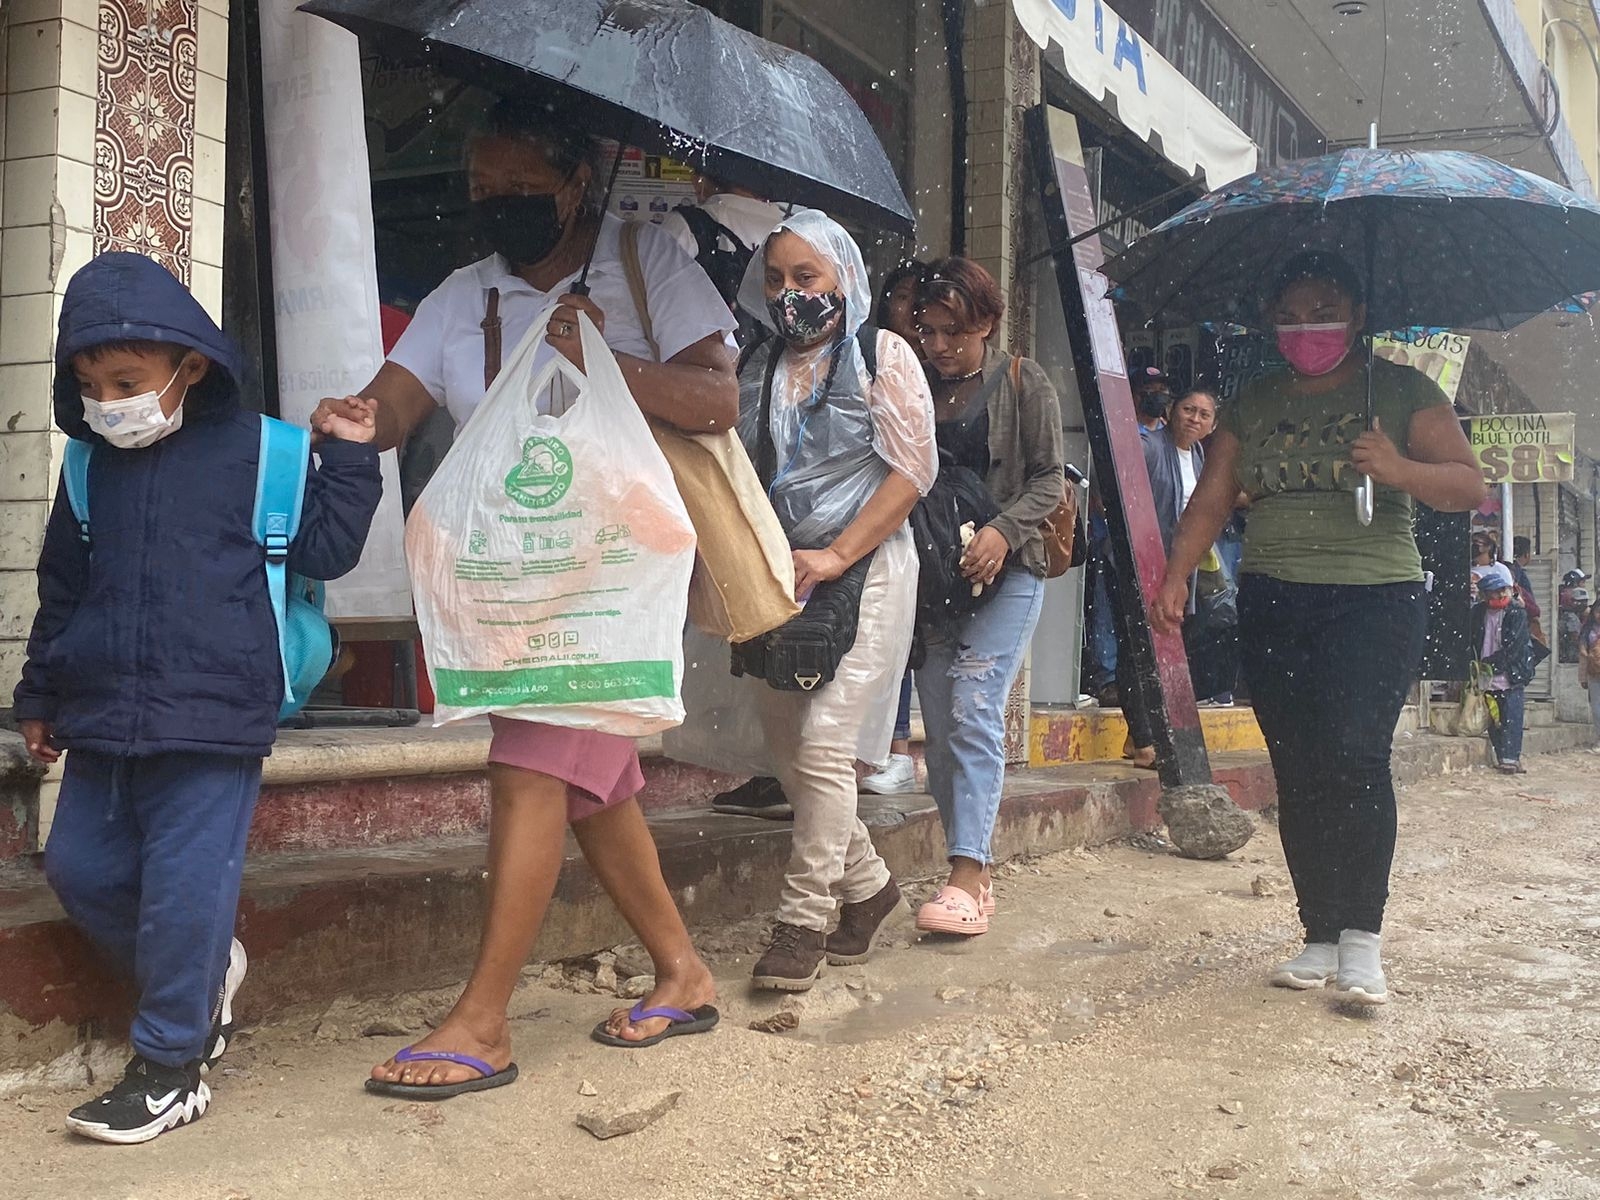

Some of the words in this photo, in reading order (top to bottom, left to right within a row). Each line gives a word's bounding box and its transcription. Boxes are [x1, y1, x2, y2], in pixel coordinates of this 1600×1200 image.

[1049, 0, 1147, 96] IA
[1479, 414, 1547, 433] BOCINA
[1472, 431, 1550, 446] BLUETOOTH
[1479, 443, 1572, 481] $85
[529, 509, 582, 523] tranquilidad
